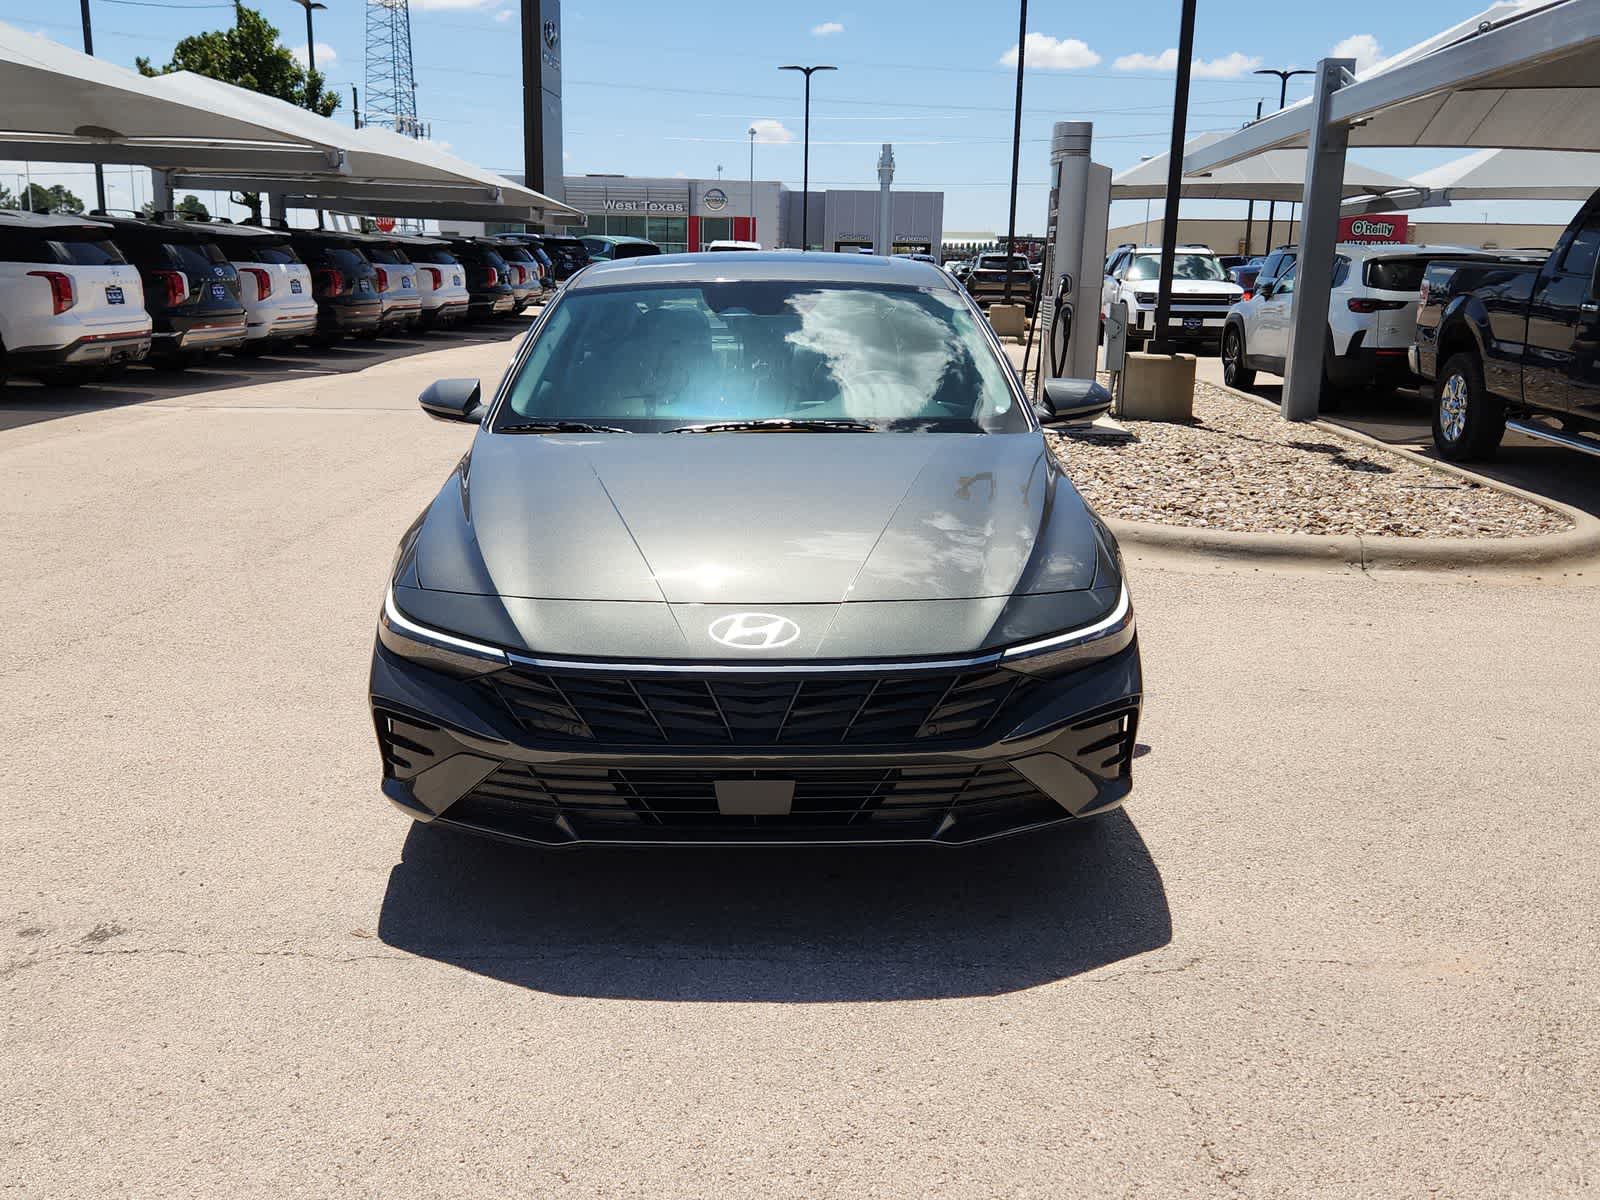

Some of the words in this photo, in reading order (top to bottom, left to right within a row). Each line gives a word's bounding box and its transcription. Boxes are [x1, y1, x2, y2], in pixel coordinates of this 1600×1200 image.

[602, 199, 638, 211] West
[641, 200, 684, 212] Texas
[1351, 219, 1395, 238] O'Reilly
